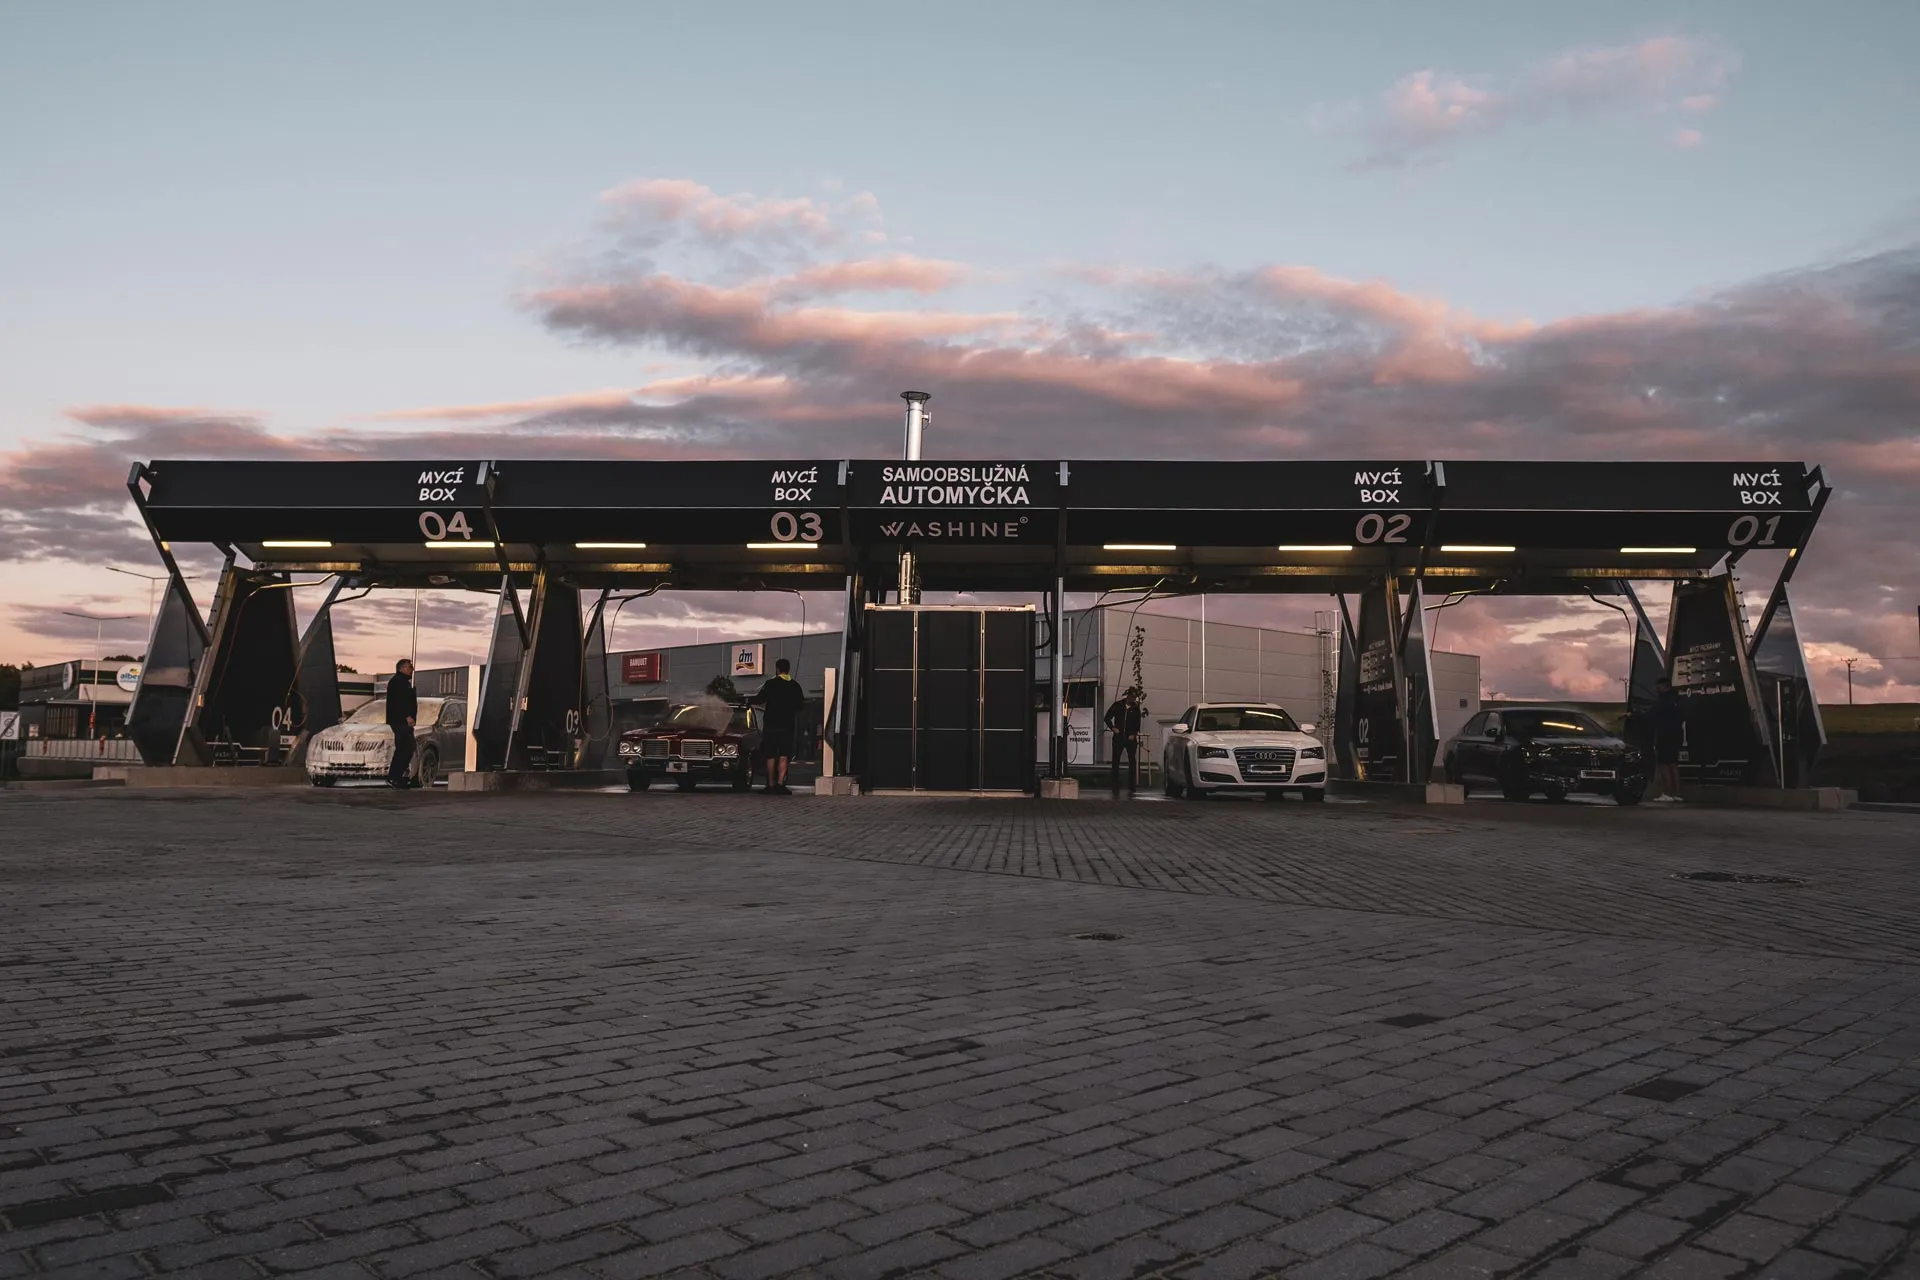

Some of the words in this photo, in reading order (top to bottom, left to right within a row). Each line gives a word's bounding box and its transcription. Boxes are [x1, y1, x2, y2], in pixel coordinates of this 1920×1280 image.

[418, 467, 464, 484] MYCÍ
[771, 467, 818, 484] MYCÍ
[882, 464, 1029, 482] SAMOOBSLUŽNÁ
[1354, 467, 1402, 485] MYCÍ
[1733, 469, 1782, 486] MYCÍ
[419, 488, 457, 501] BOX
[774, 487, 812, 501] BOX
[880, 482, 1030, 504] AUTOMYČKA
[1360, 489, 1400, 503] BOX
[1740, 491, 1782, 505] BOX
[418, 511, 473, 541] 04
[770, 511, 823, 542] 03
[1355, 513, 1412, 544] 02
[1727, 515, 1782, 546] 01
[739, 649, 752, 663] dm
[271, 706, 293, 732] 04
[566, 709, 579, 735] 03
[1358, 717, 1369, 744] 02
